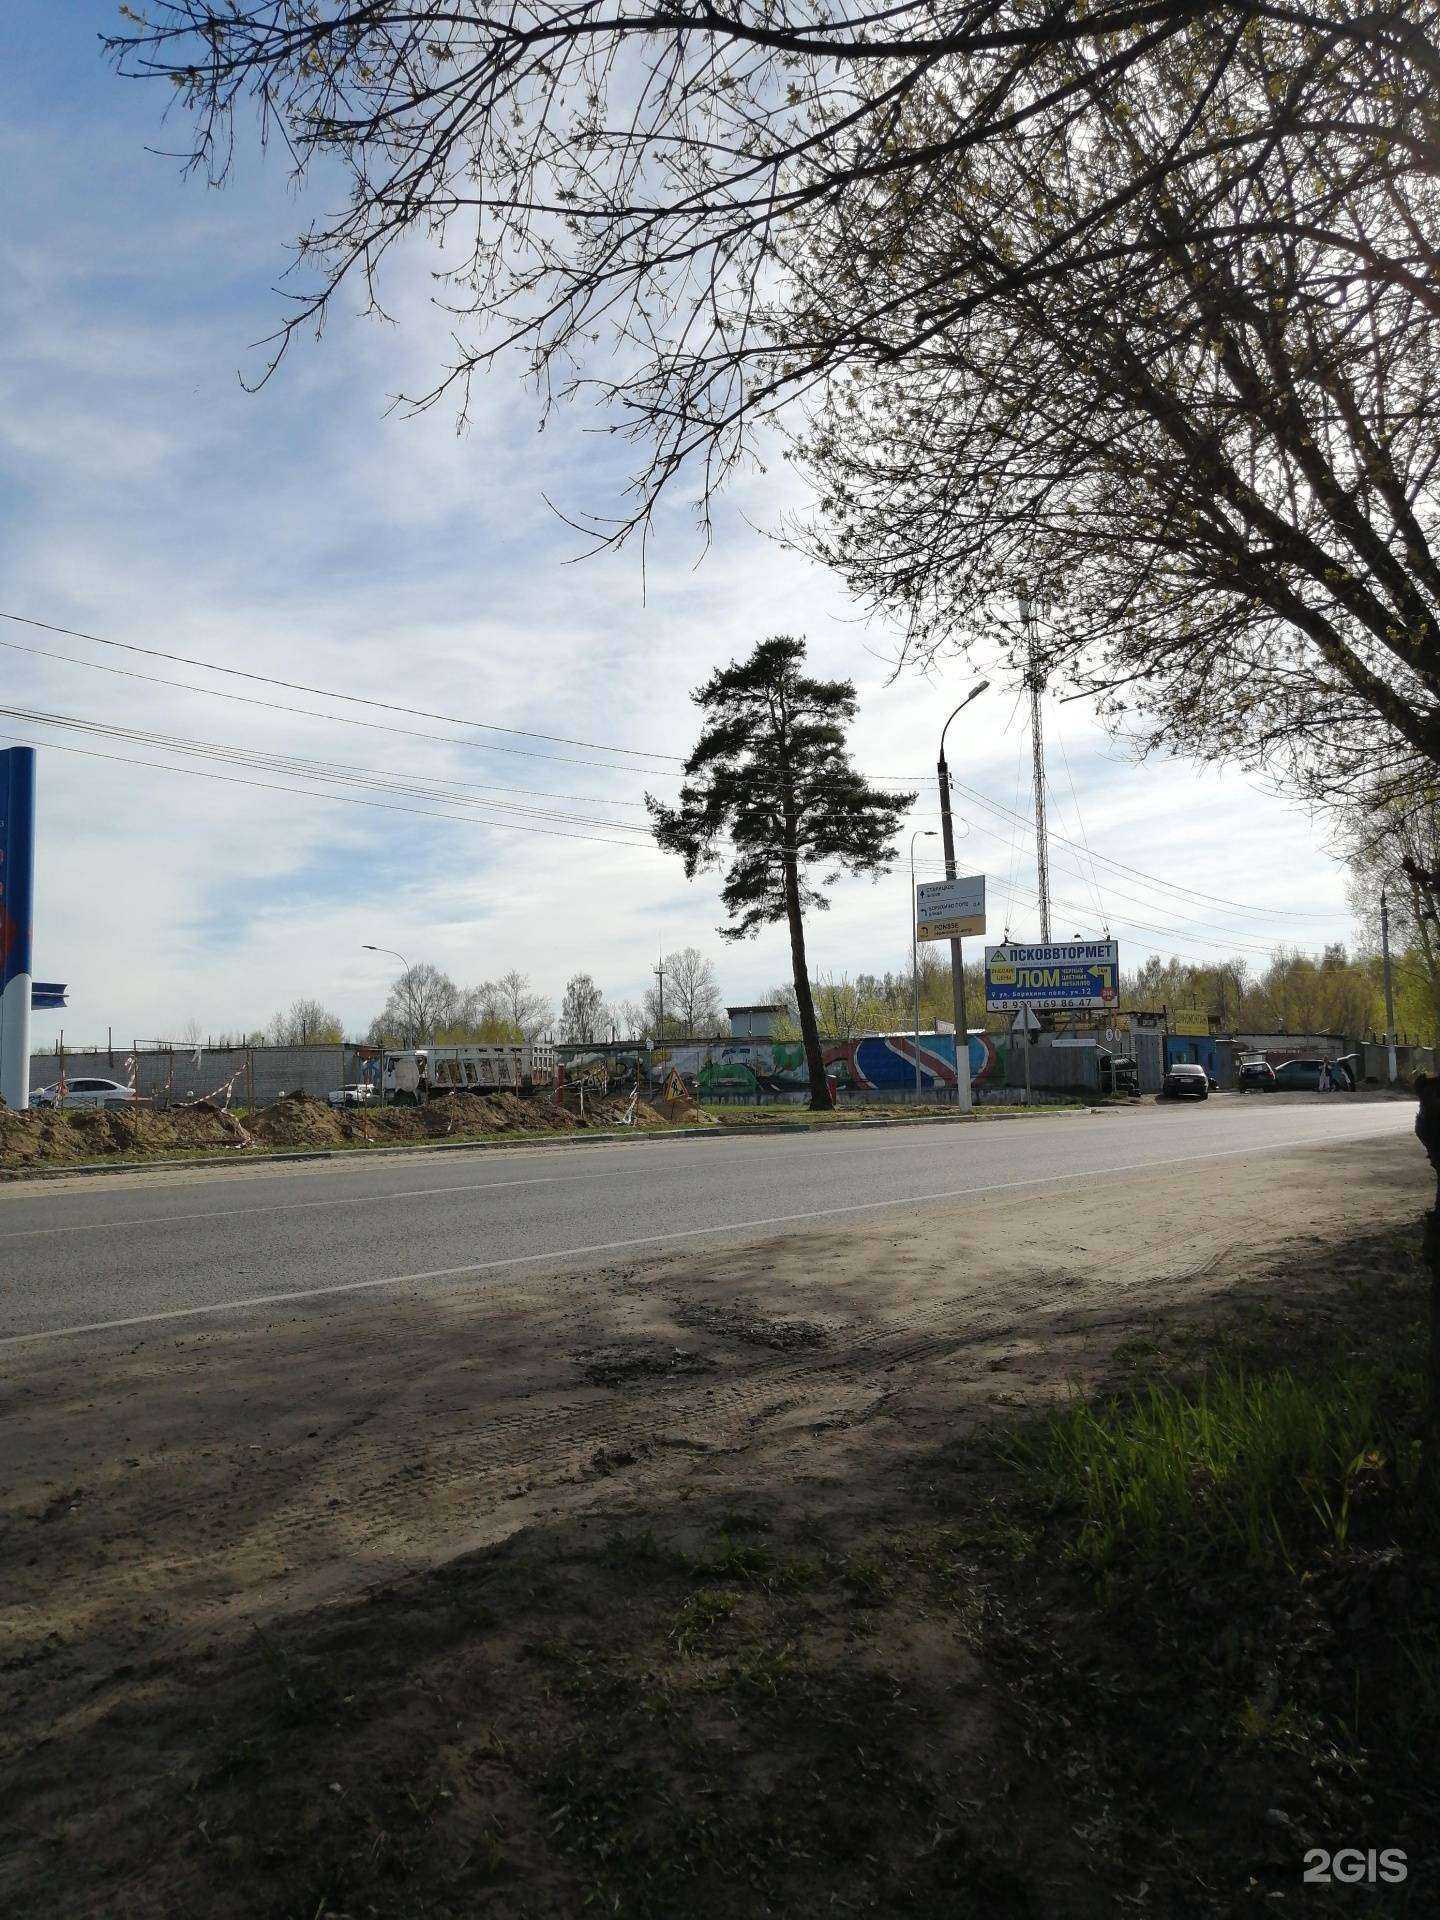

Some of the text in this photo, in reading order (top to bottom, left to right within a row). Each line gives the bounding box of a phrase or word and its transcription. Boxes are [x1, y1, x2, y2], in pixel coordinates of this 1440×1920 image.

[1009, 944, 1112, 962] ПСКОВВТОРМЕТ
[1016, 968, 1060, 988] ЛОМ
[1002, 1001, 1008, 1009] 8
[1038, 999, 1056, 1008] 169
[1061, 999, 1074, 1007] 86
[1079, 998, 1092, 1007] 47
